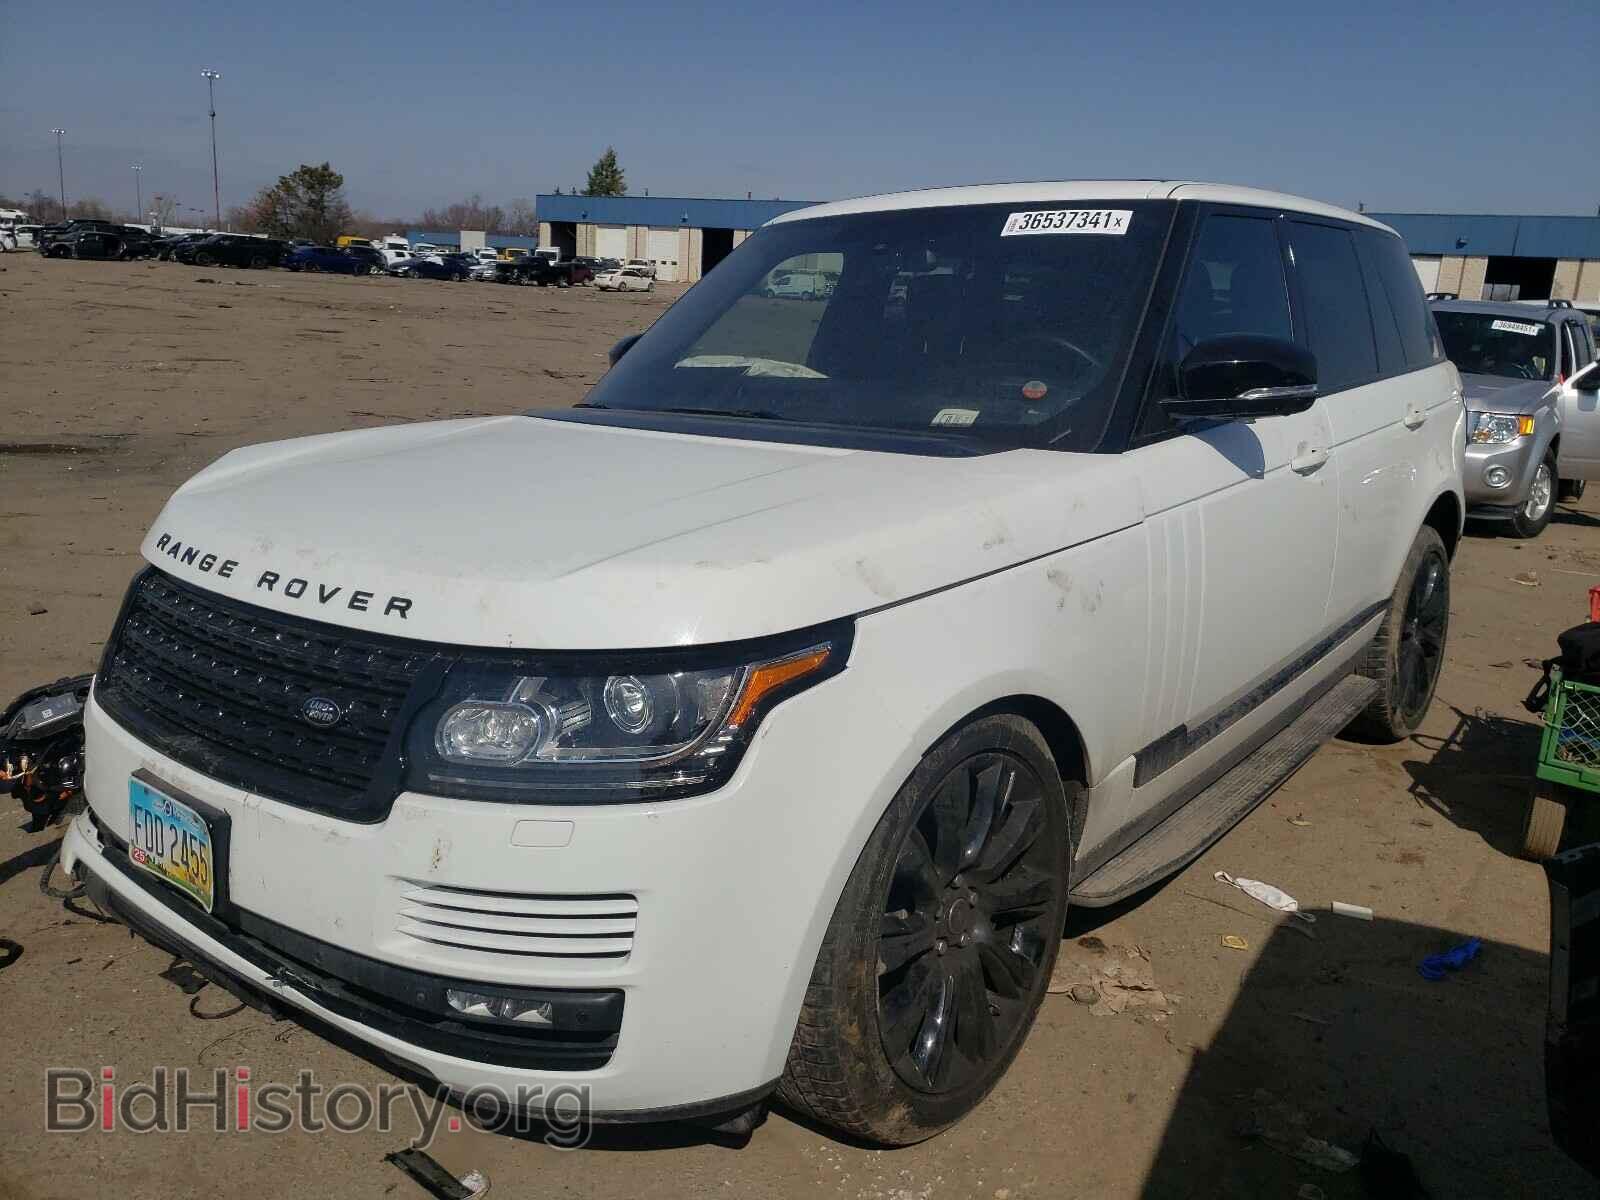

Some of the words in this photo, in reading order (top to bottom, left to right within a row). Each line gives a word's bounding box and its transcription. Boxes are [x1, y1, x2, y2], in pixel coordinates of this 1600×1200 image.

[1019, 211, 1112, 230] 36537341
[156, 533, 239, 578] RANGE
[256, 570, 413, 619] ROVER
[134, 849, 145, 862] 25
[169, 826, 208, 883] 2455
